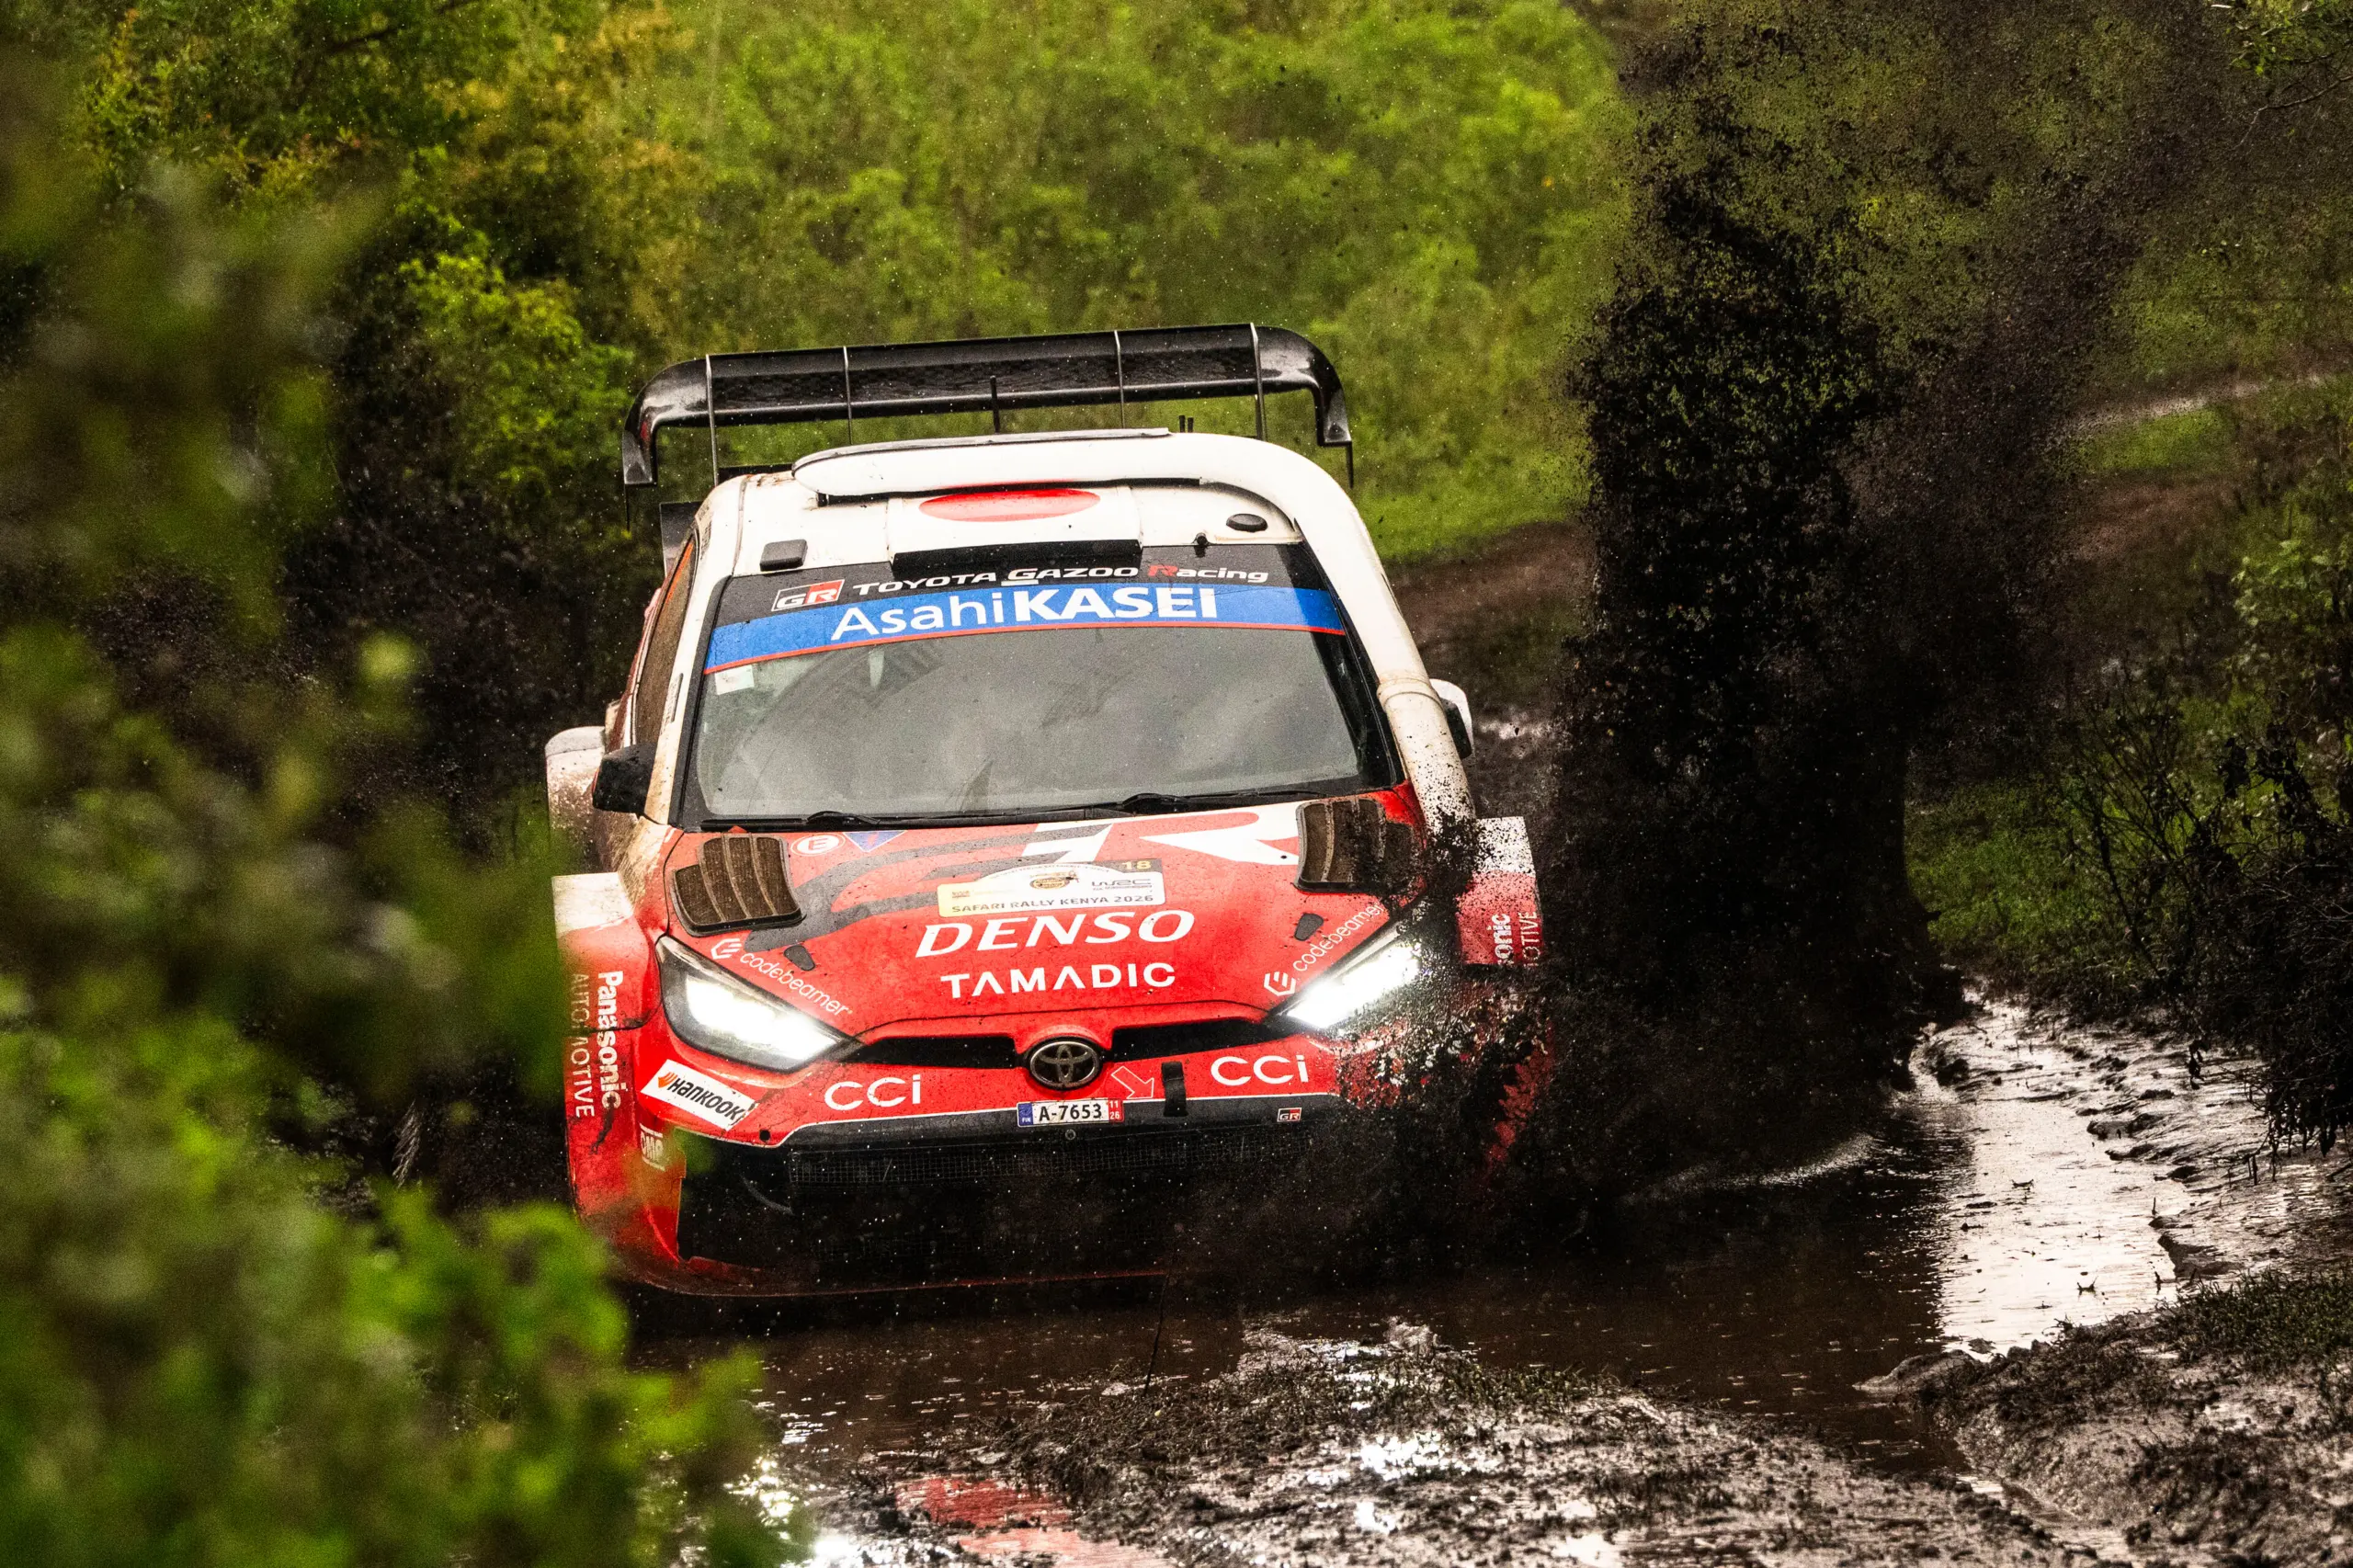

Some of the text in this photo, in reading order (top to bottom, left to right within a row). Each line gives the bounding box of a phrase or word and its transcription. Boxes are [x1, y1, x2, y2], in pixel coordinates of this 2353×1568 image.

[853, 565, 1268, 596] TOYOTA GAZOO Racing
[1122, 860, 1152, 870] 18
[951, 894, 1154, 913] SAFARI RALLY KENYA 2026
[915, 910, 1195, 959] DENSO
[1293, 901, 1384, 971] codebeamer
[740, 953, 848, 1016] codebeamer
[940, 962, 1176, 998] TAMADIC
[597, 971, 627, 1109] Panasonic
[1039, 1104, 1102, 1121] A-7653
[1109, 1100, 1119, 1108] 11
[1109, 1111, 1120, 1119] 26
